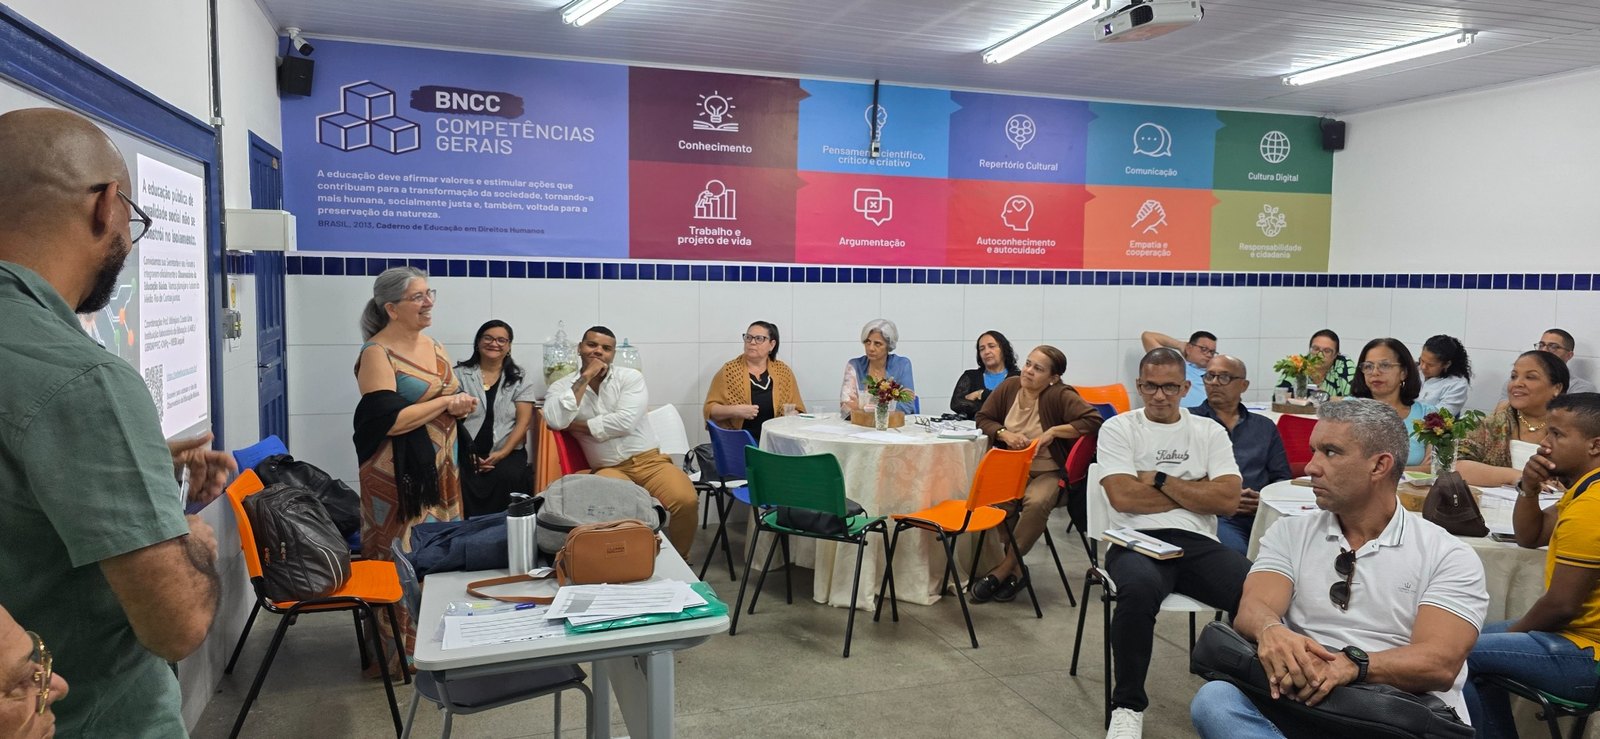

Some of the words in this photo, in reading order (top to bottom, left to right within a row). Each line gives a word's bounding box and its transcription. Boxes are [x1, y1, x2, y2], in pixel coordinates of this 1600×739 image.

[435, 91, 500, 112] BNCC
[436, 118, 595, 142] COMPETÊNCIAS
[436, 136, 512, 155] GERAIS
[678, 140, 752, 153] Conhecimento
[823, 146, 880, 157] Pensamen
[881, 151, 926, 160] científico,
[838, 156, 868, 165] crítico
[876, 159, 911, 168] criativo
[979, 159, 1024, 170] Repertório
[1025, 161, 1058, 172] Cultural
[1125, 166, 1178, 178] Comunicação
[1248, 172, 1274, 181] Cultura
[1275, 173, 1299, 183] Digital
[317, 170, 324, 178] A
[327, 170, 375, 180] educação
[378, 173, 401, 181] deve
[403, 174, 438, 183] afirmar
[440, 176, 474, 185] valores
[484, 179, 526, 187] estimular
[528, 181, 555, 190] ações
[142, 178, 147, 192] A
[148, 181, 171, 201] educação
[188, 193, 194, 206] de
[318, 182, 375, 192] contribuam
[377, 185, 400, 194] para
[409, 186, 478, 197] transformação
[494, 190, 542, 200] sociedade,
[544, 193, 594, 202] tornando-a
[318, 194, 342, 202] mais
[344, 195, 386, 205] humana,
[388, 197, 447, 207] socialmente
[448, 200, 472, 209] justa
[484, 201, 524, 210] também,
[526, 203, 559, 212] voltada
[561, 205, 580, 213] para
[318, 207, 380, 217] preservação
[396, 210, 441, 218] natureza.
[376, 222, 410, 230] Caderno
[424, 224, 463, 232] Educação
[689, 226, 732, 236] Trabalho
[678, 235, 714, 247] projeto
[716, 236, 729, 246] de
[731, 236, 752, 246] vida
[839, 237, 906, 248] Argumentação
[976, 237, 1056, 248] Autoconhecimento
[1129, 240, 1161, 250] Empatia
[1240, 242, 1302, 252] Responsabilidade
[993, 246, 1046, 255] autocuidado
[1126, 248, 1171, 258] cooperação
